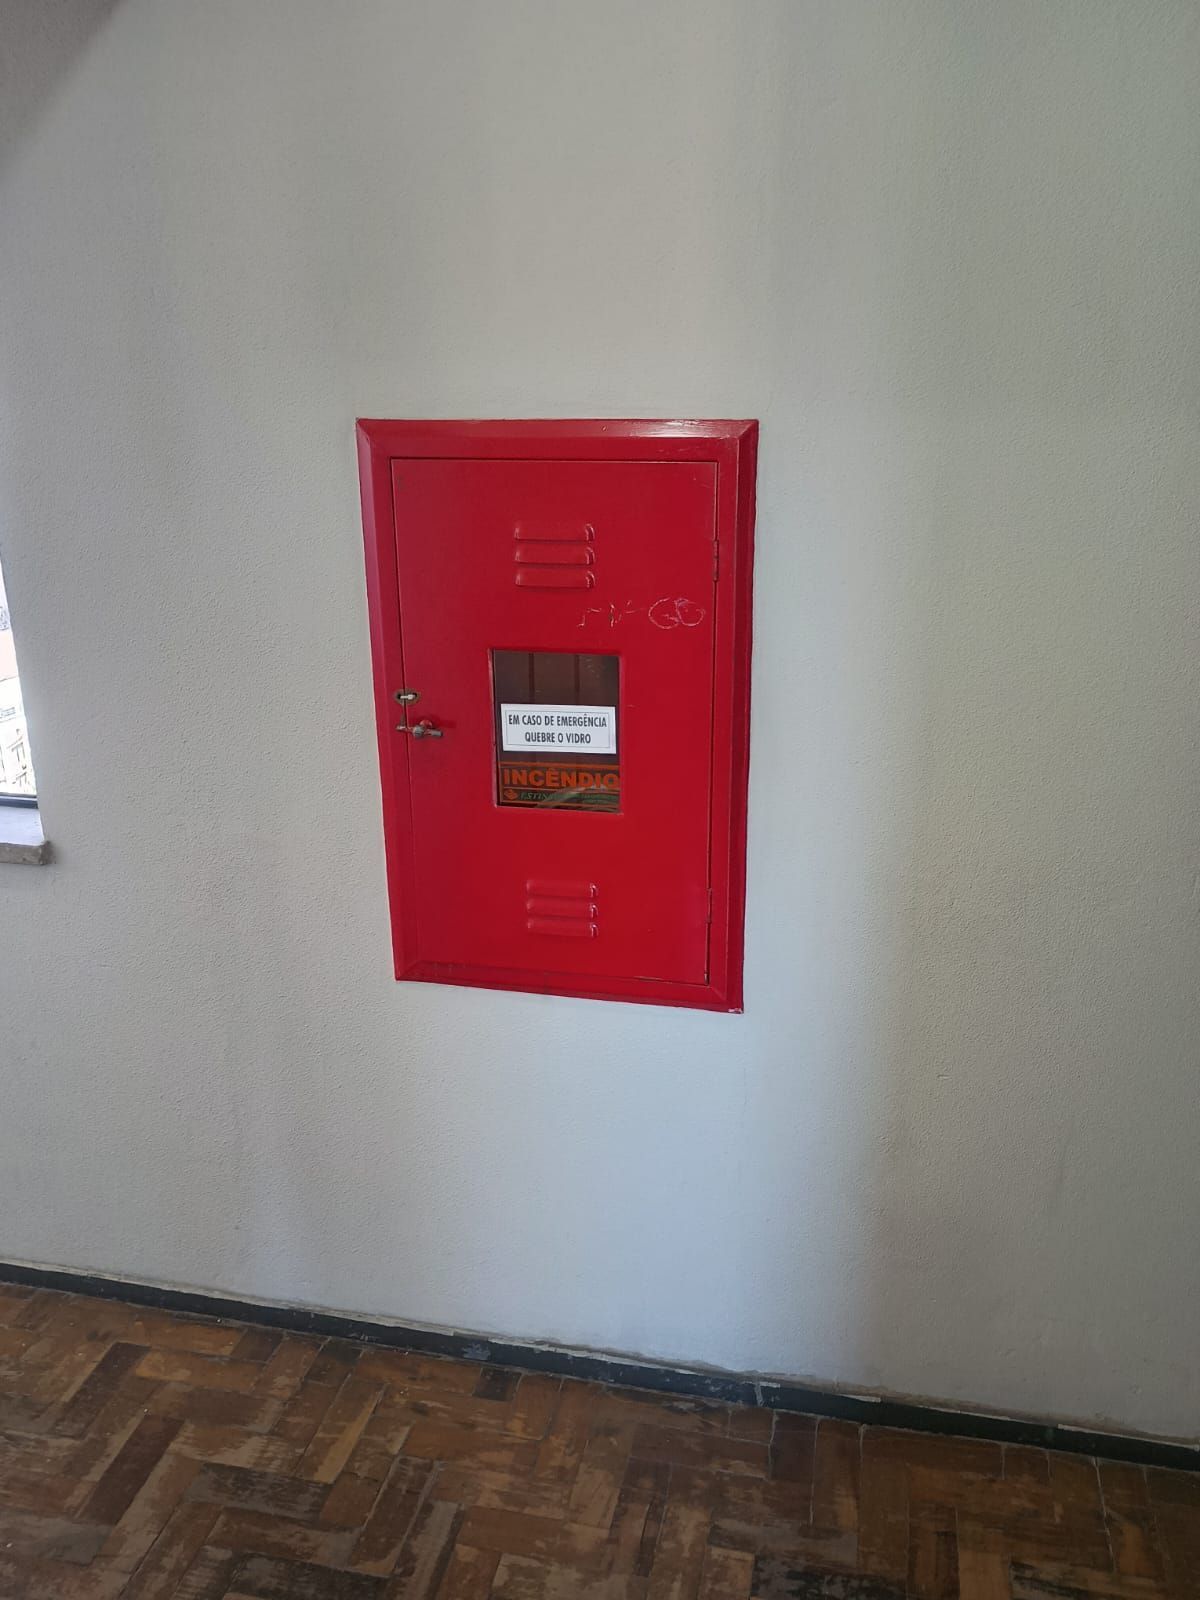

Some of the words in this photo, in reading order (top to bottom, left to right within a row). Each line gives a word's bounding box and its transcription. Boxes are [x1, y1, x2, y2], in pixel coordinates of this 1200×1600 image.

[508, 714, 520, 725] EM
[522, 714, 542, 726] CASO
[544, 715, 555, 727] DE
[556, 713, 608, 728] EMERGÊNCIA
[524, 731, 556, 743] QUEBRE
[557, 732, 564, 744] O
[565, 732, 592, 744] VIDRO
[503, 767, 619, 789] INCÊNDIO
